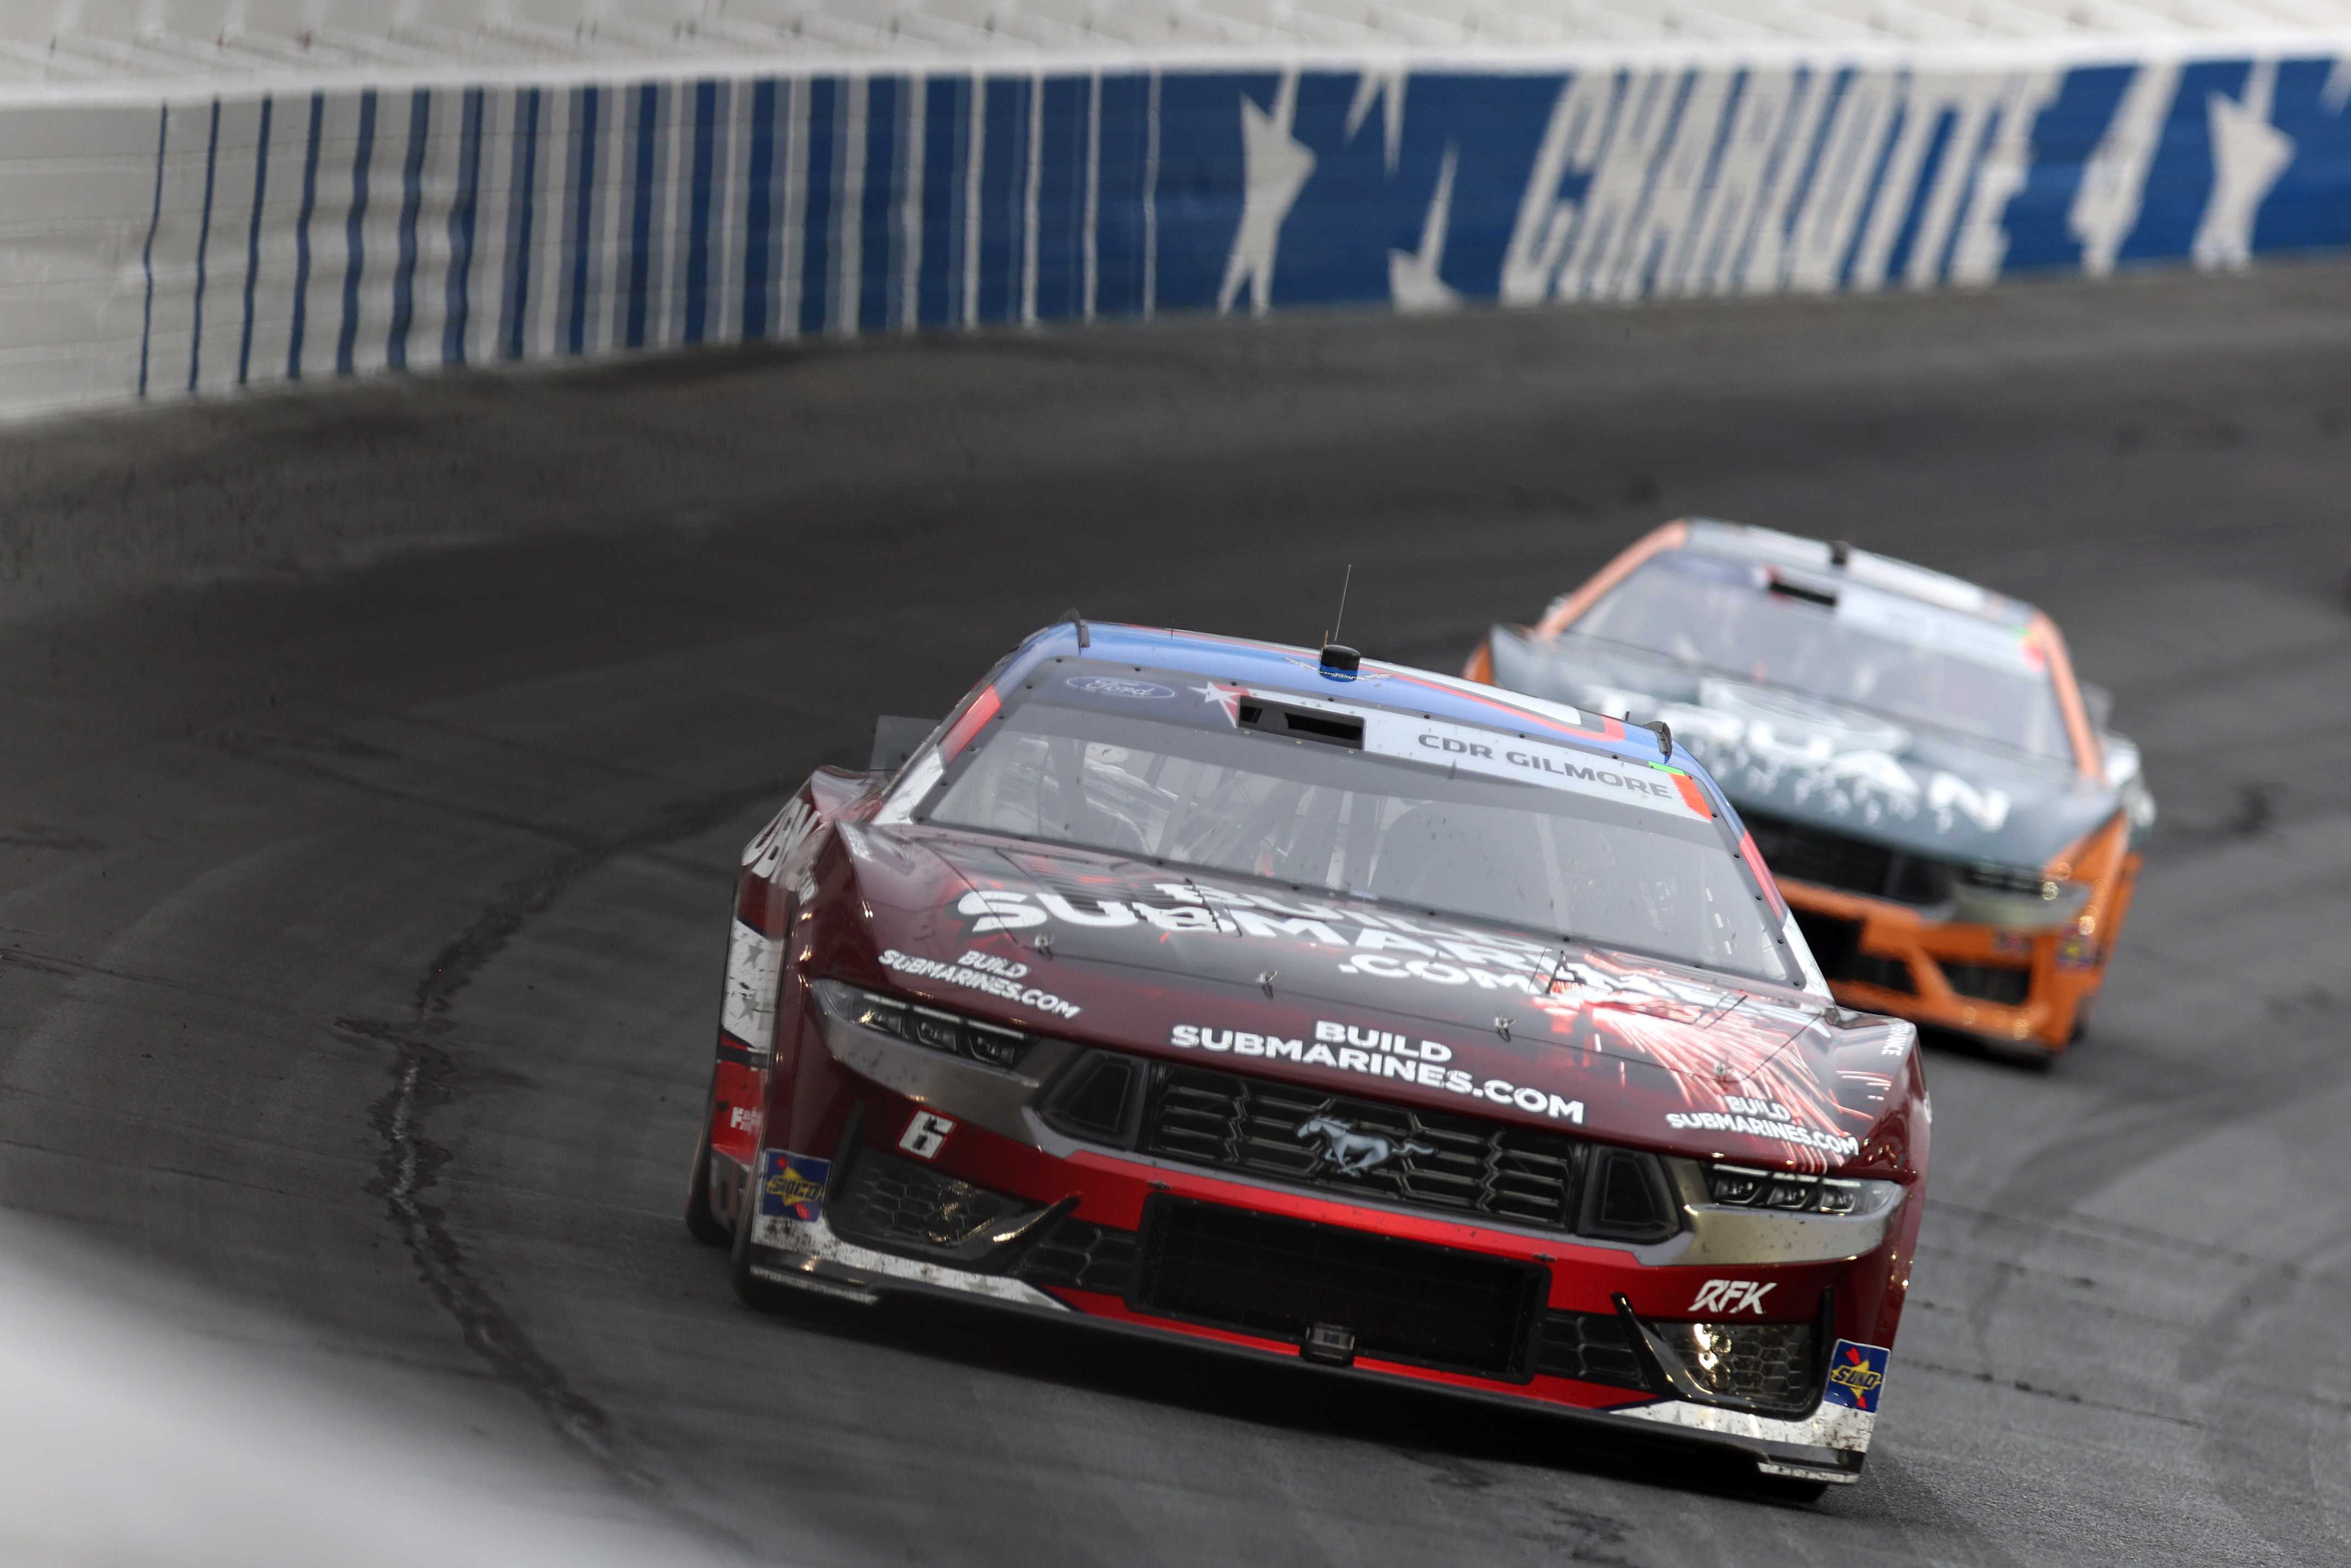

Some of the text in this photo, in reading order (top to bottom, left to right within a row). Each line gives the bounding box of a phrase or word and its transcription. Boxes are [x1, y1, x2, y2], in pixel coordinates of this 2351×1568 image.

[1499, 61, 2069, 306] CHARLOTTE
[1418, 734, 1672, 800] CDR GILMORE
[878, 949, 1082, 1019] SUBMARINES.COM
[958, 950, 1028, 978] BUILD
[1339, 954, 1542, 995] .COM
[1315, 1020, 1453, 1062] BUILD
[1170, 1024, 1585, 1125] SUBMARINES.COM
[1725, 1095, 1791, 1122] BUILD
[899, 1110, 953, 1159] 6
[1665, 1112, 1860, 1156] SUBMARINES.COM
[1688, 1279, 1778, 1314] RFK
